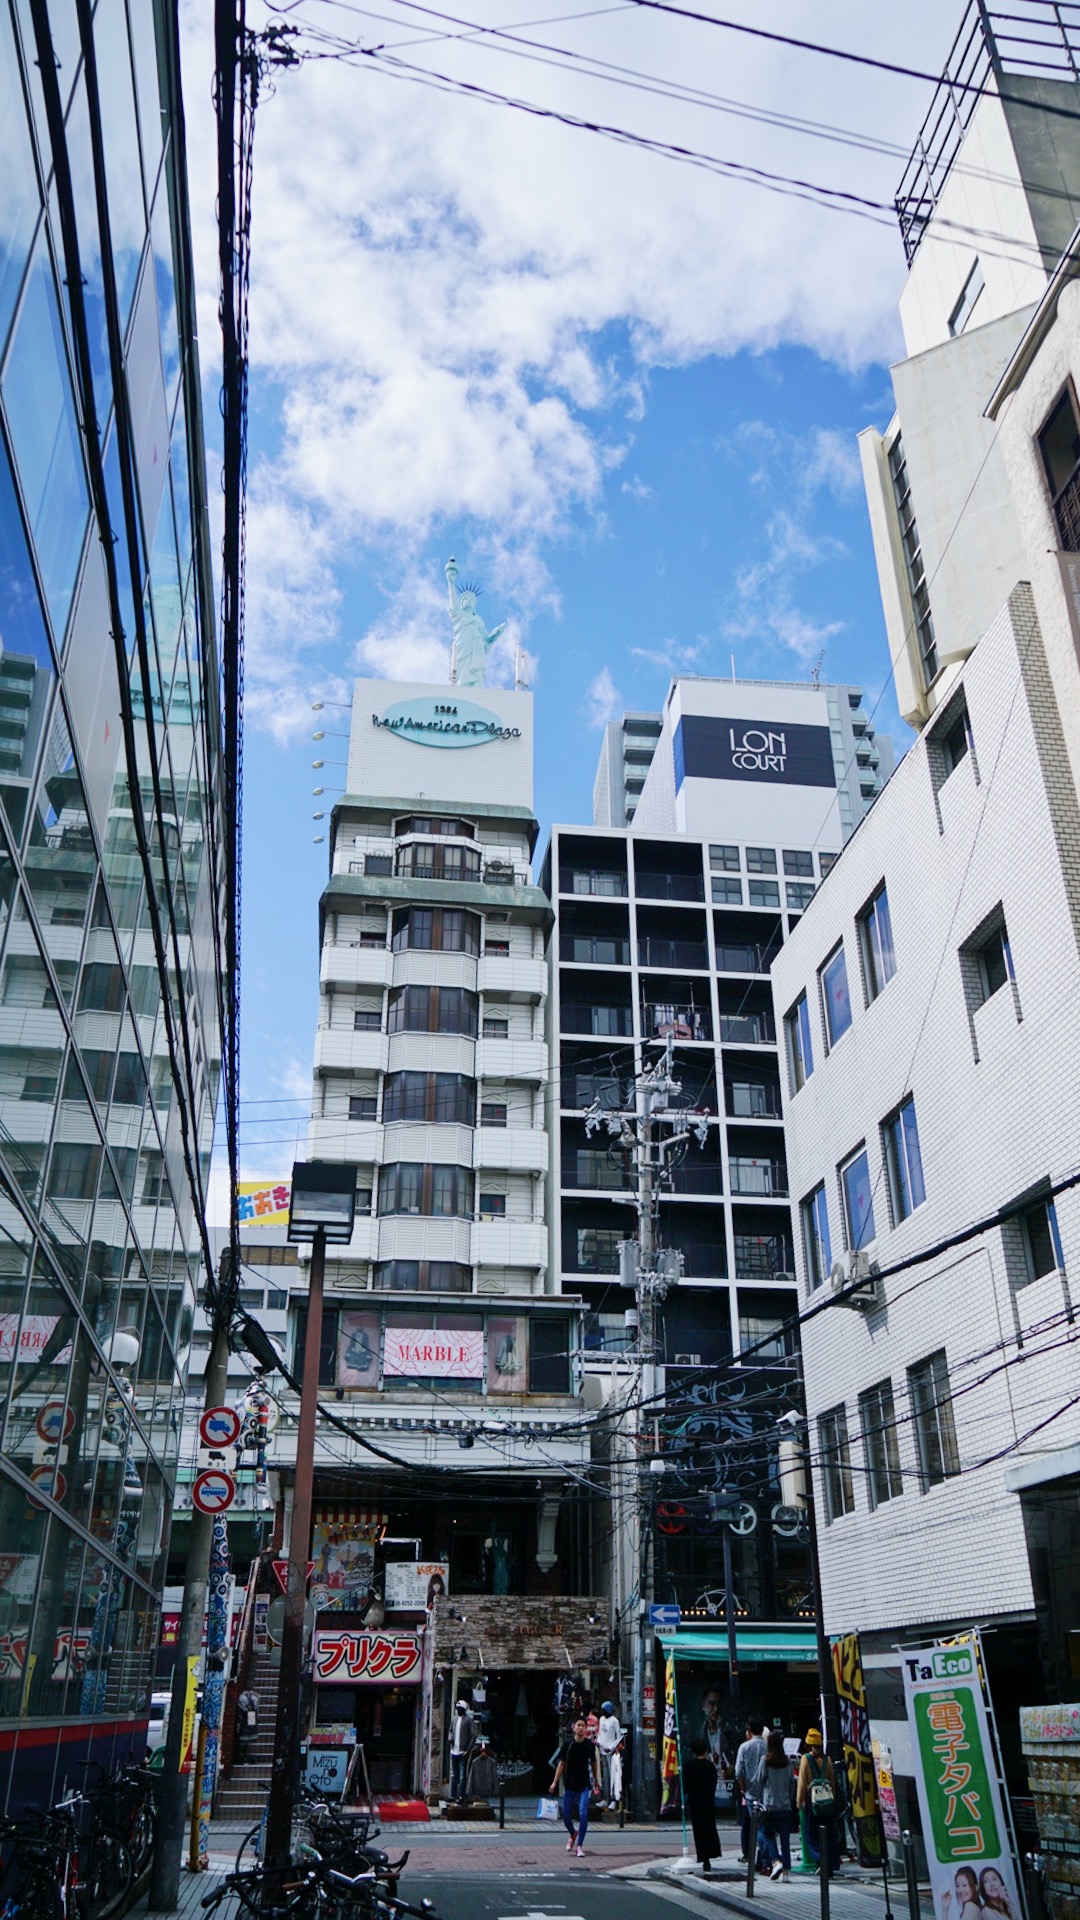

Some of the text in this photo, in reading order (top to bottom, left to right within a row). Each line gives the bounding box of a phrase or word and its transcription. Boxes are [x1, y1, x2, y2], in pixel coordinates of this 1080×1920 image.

[372, 714, 521, 740] New American Plaza
[730, 728, 786, 755] LON
[732, 753, 787, 771] COURT
[397, 1345, 470, 1362] MARBLE
[318, 1634, 420, 1677] プリクラ
[928, 1701, 985, 1857] 電子タバコ
